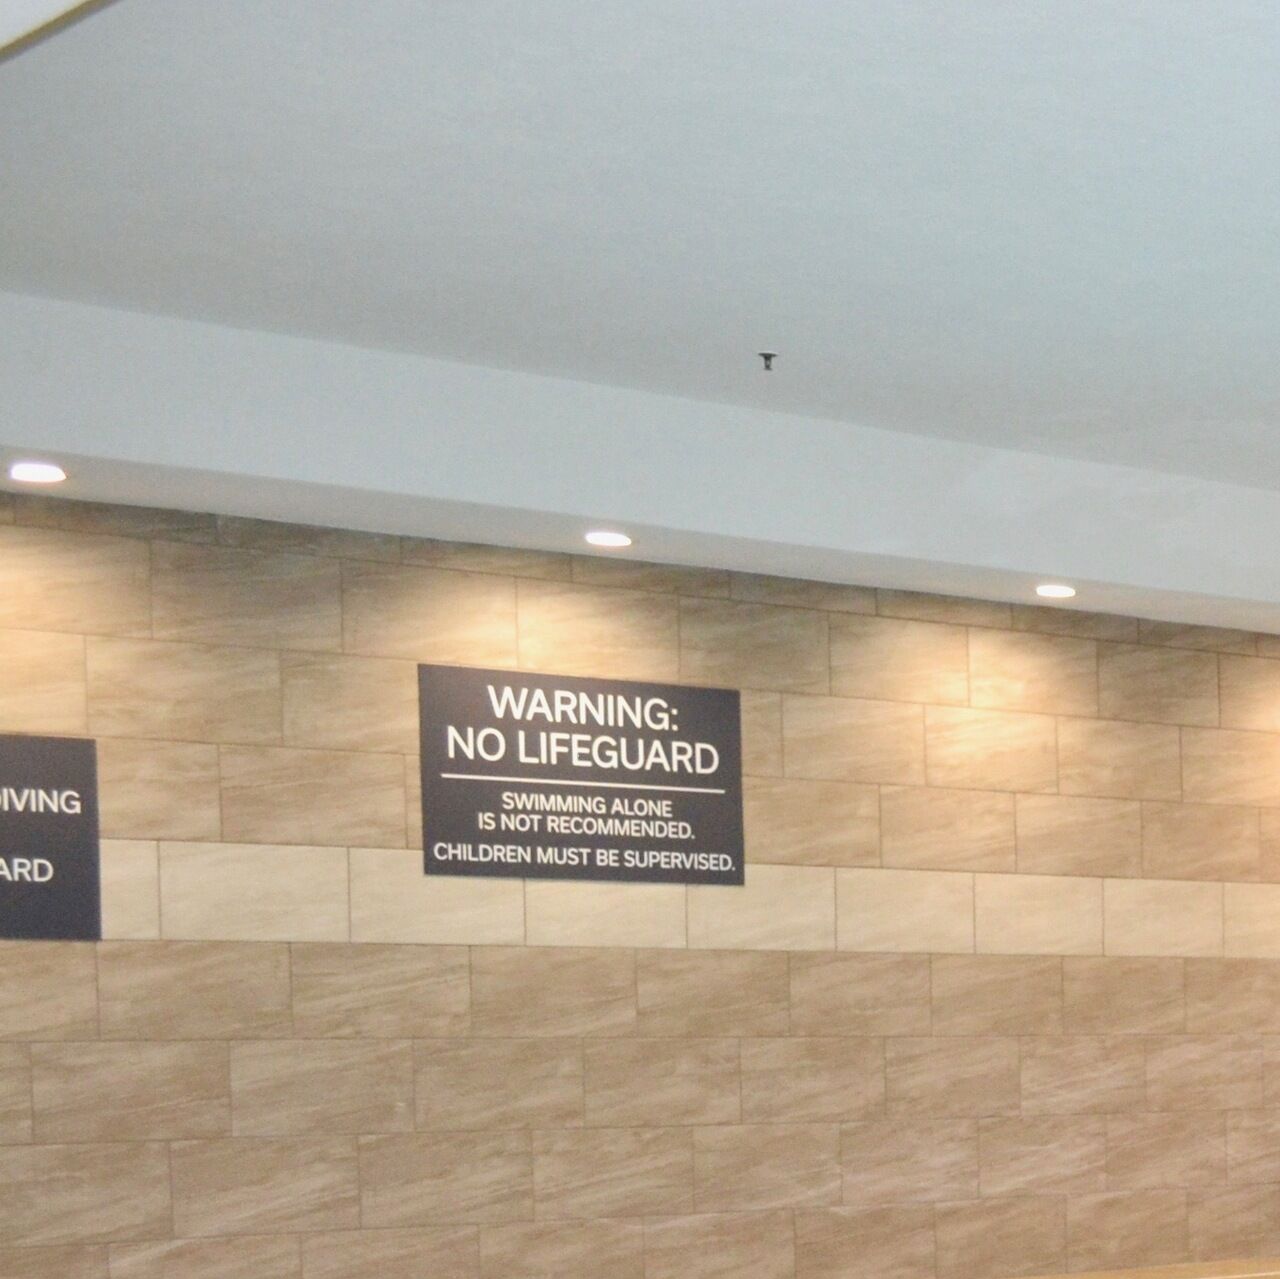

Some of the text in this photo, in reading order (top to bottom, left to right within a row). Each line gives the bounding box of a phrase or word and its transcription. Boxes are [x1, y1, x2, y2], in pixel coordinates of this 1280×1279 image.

[486, 684, 679, 732] WARNING:
[447, 725, 720, 775] NO LIFEGUARD
[0, 787, 82, 814] IVING
[501, 791, 673, 818] SWIMMING ALONE
[478, 812, 696, 840] IS NOT RECOMMENDED.
[433, 842, 736, 872] CHILDREN MUST BE SUPERVISED.
